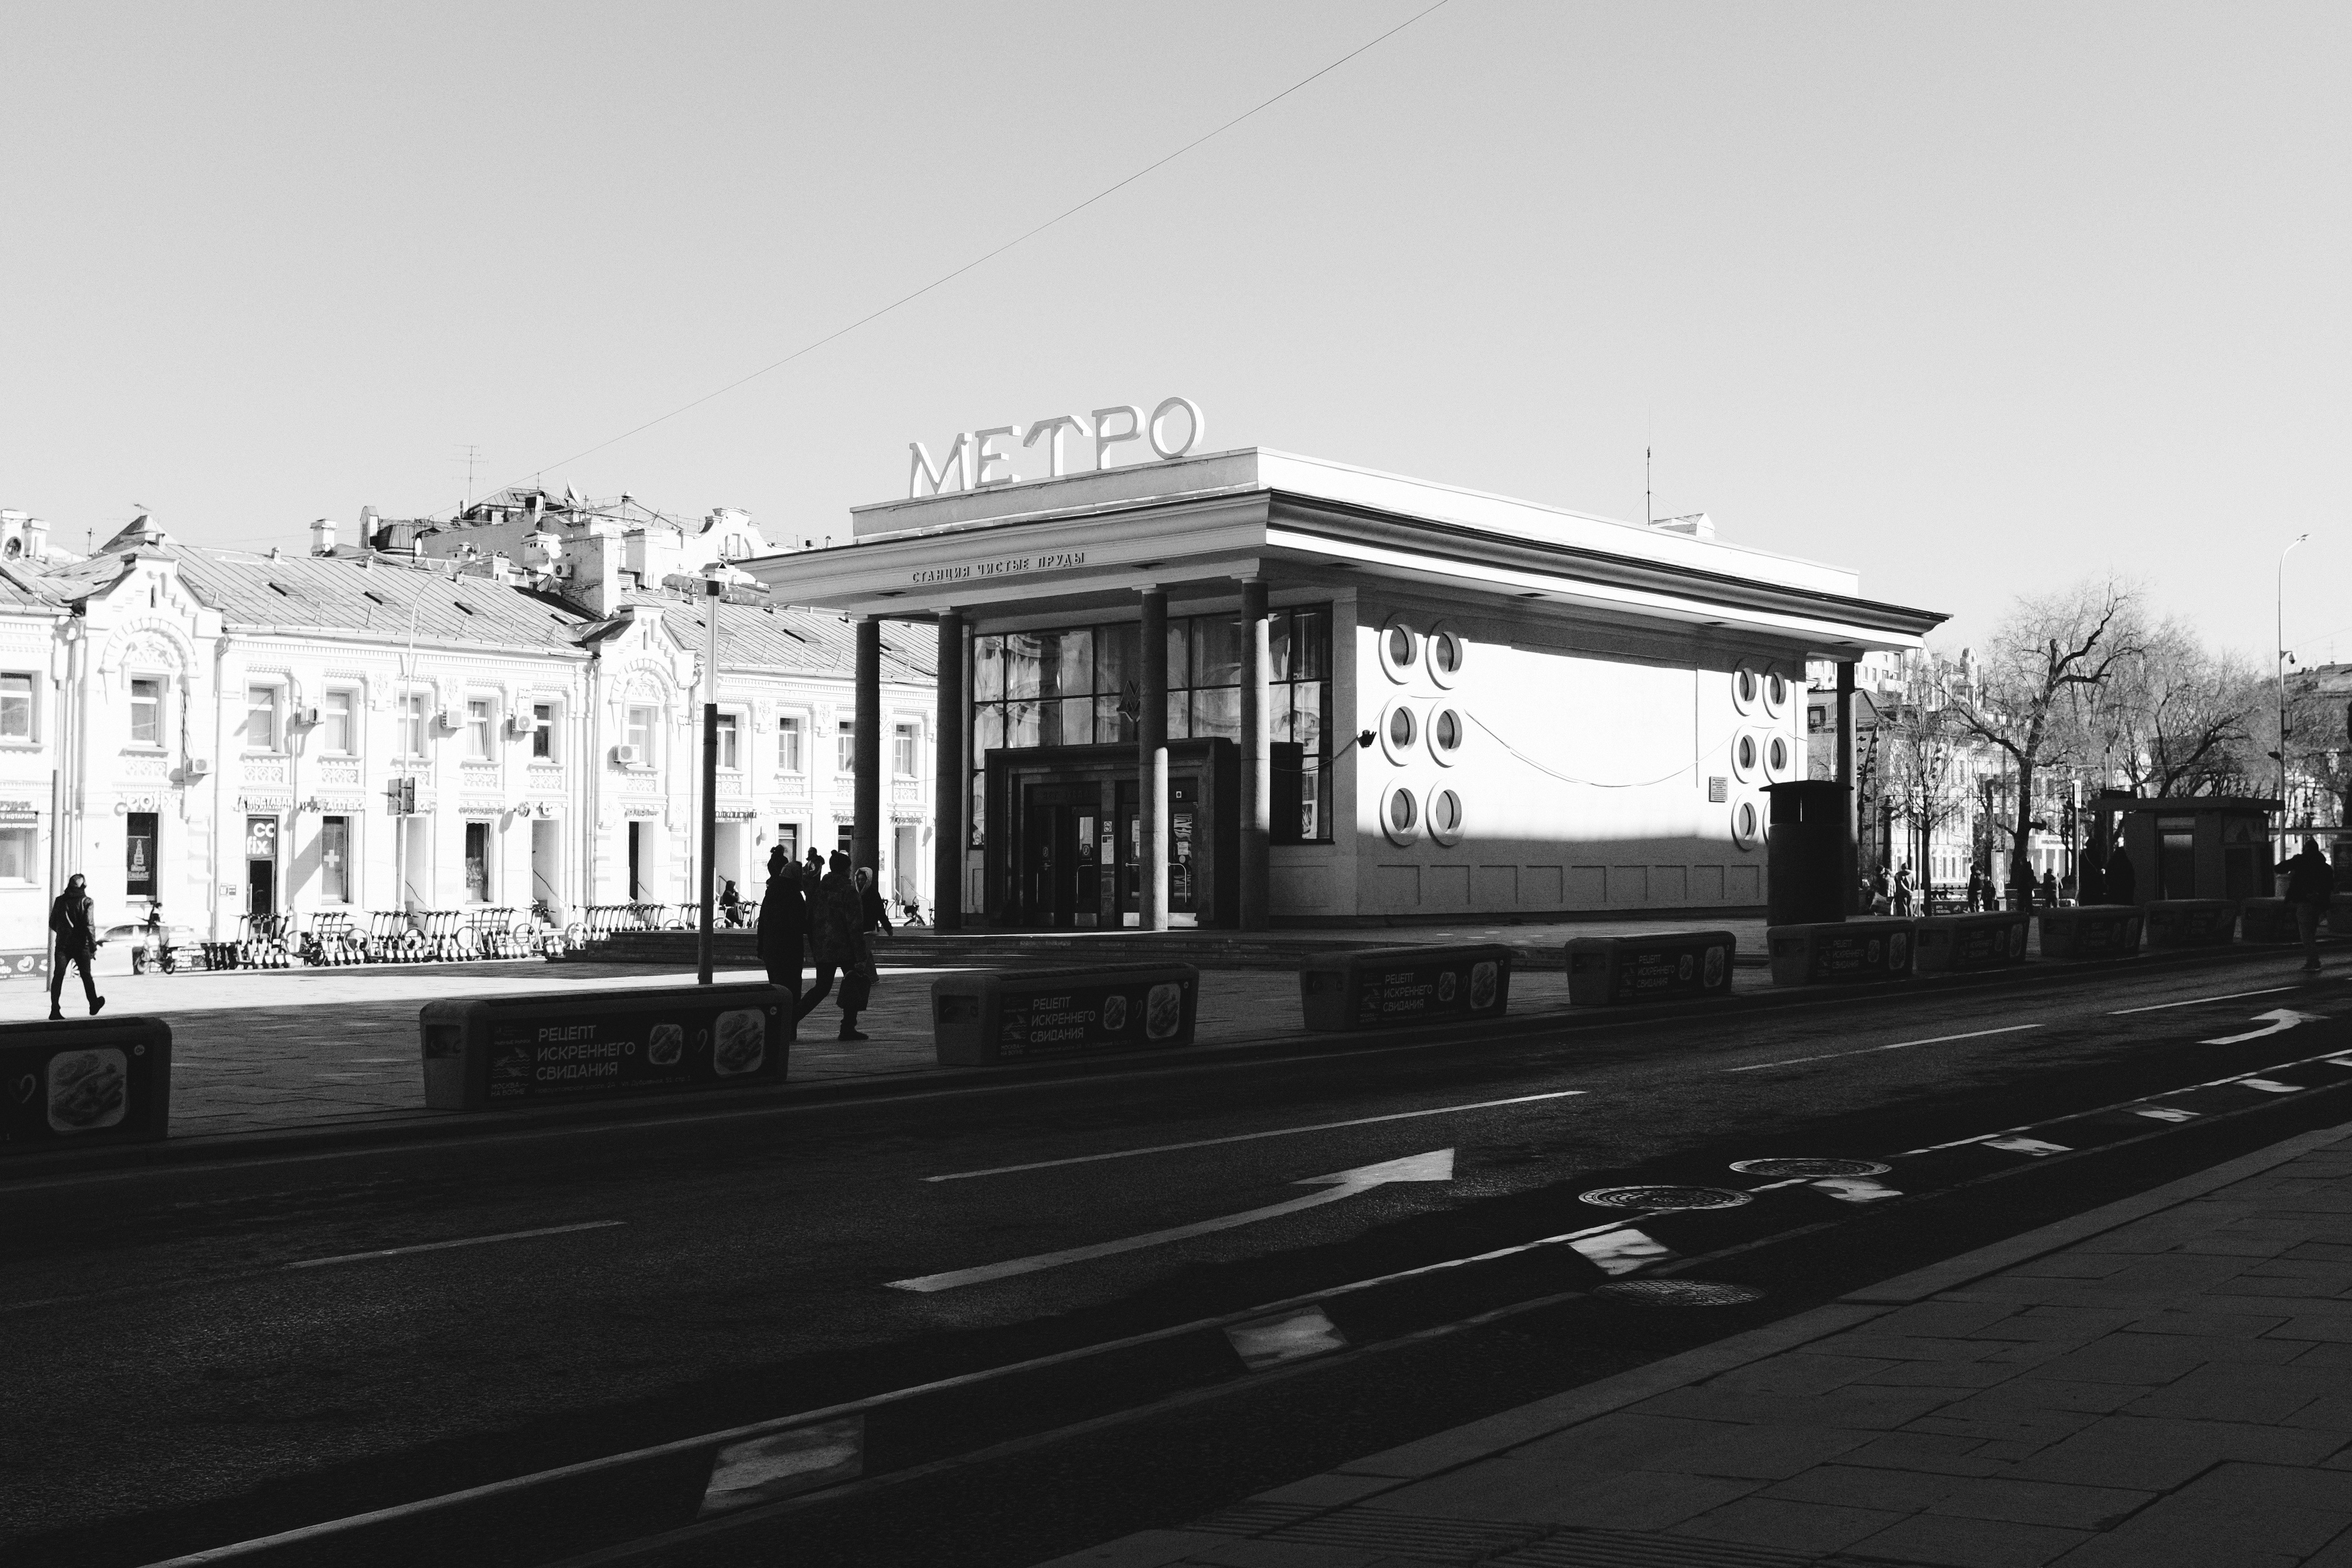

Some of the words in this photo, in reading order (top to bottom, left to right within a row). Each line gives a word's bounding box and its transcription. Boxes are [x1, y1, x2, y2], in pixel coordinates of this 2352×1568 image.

[909, 396, 1205, 498] МЕТРО
[912, 566, 970, 584] СТАНЦИЯ
[978, 558, 1029, 575] ЧИСТЫЕ
[1038, 552, 1085, 568] ПРУДЫ
[327, 800, 366, 810] АПТЕКА
[247, 836, 268, 855] fix
[1385, 972, 1414, 984] РЕЦЕПТ
[1384, 984, 1433, 998] ИСКРЕННЕГО
[1033, 996, 1071, 1011] РЕЦЕПТ
[1383, 999, 1424, 1012] СВИДАНИЯ
[1031, 1010, 1096, 1027] ИСКРЕННЕГО
[539, 1025, 597, 1042] РЕЦЕПТ
[1030, 1027, 1084, 1042] СВИДАНИЯ
[537, 1042, 635, 1062] ИСКРЕННЕГО
[536, 1062, 618, 1080] СВИДАНИЯ
[502, 1088, 525, 1096] ВОЛНЕ
